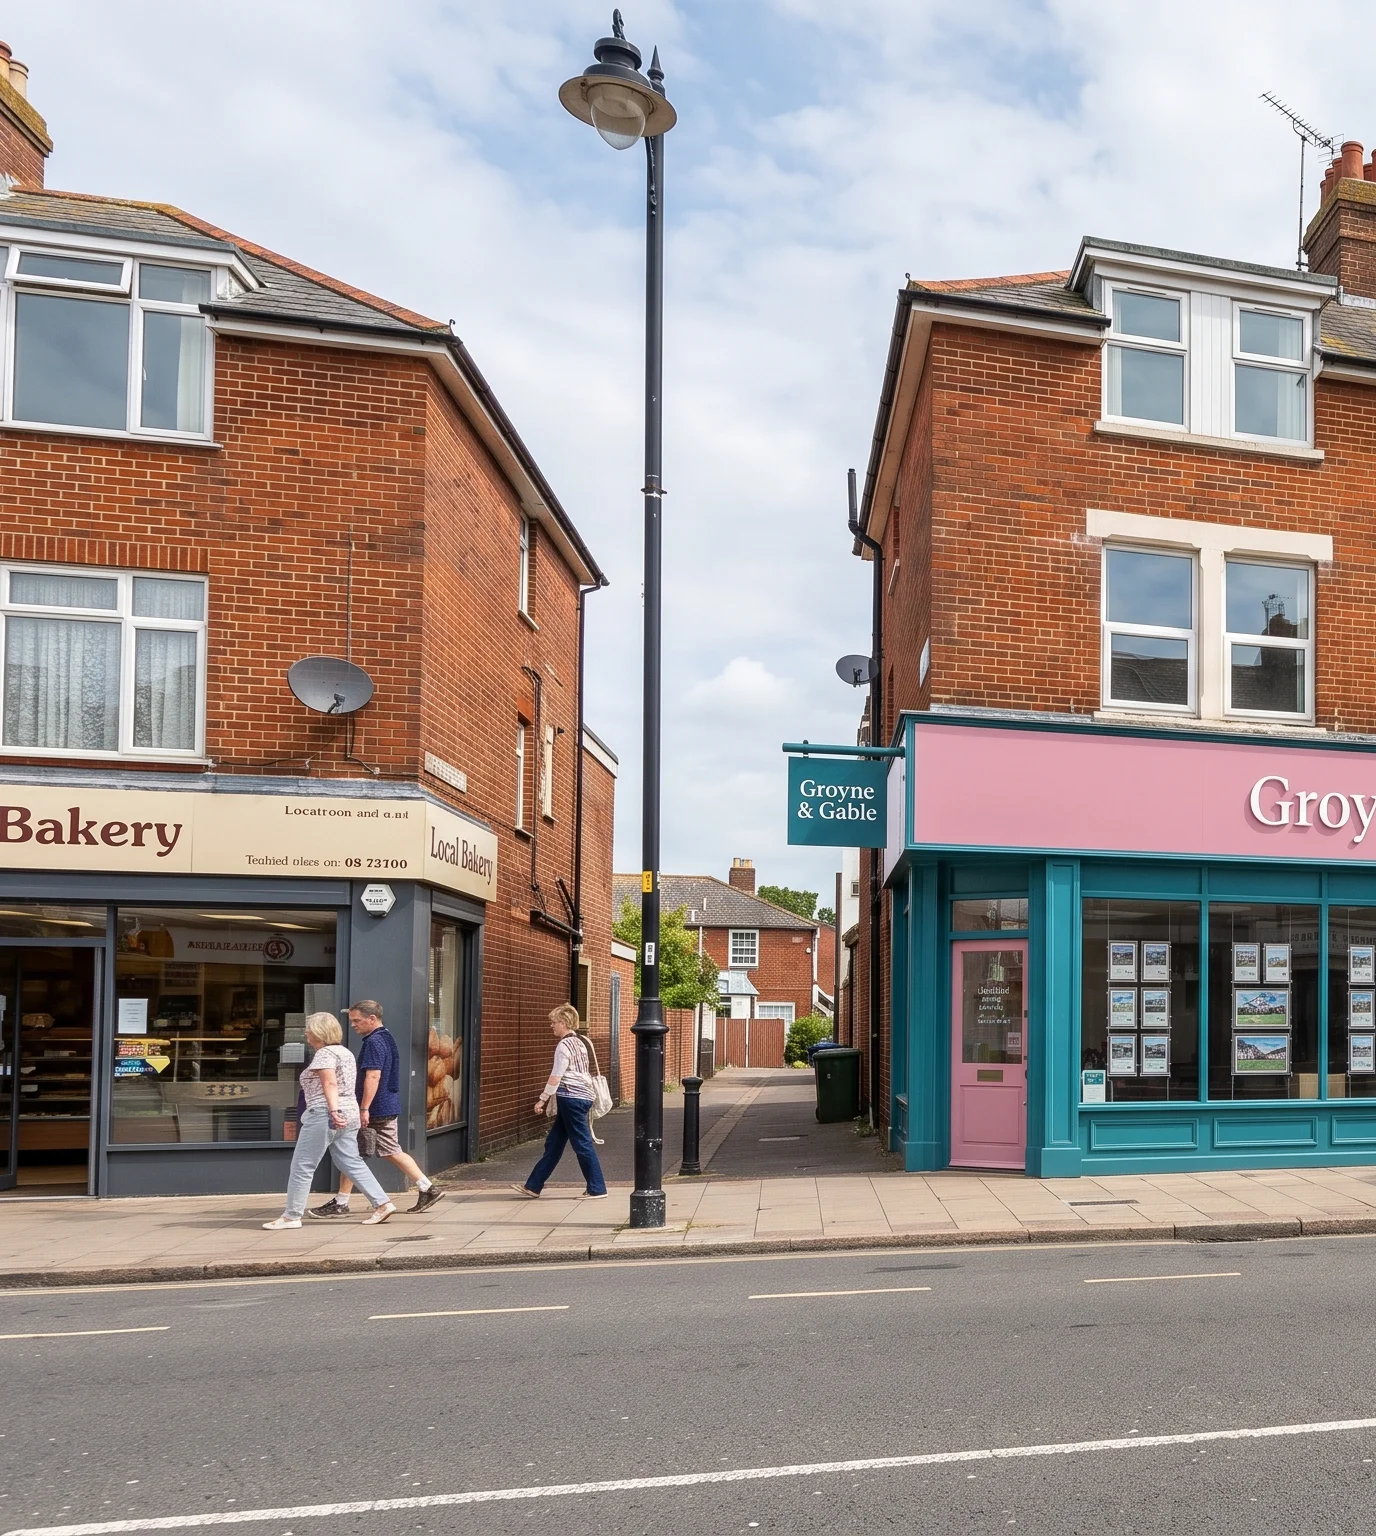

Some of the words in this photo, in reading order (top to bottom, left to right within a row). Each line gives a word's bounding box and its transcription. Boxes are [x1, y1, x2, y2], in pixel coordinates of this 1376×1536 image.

[800, 780, 875, 803] Groyne
[797, 801, 814, 819] &
[819, 802, 877, 821] Gable
[0, 805, 183, 858] Bakery
[430, 826, 459, 866] Local
[461, 839, 493, 885] Bakery
